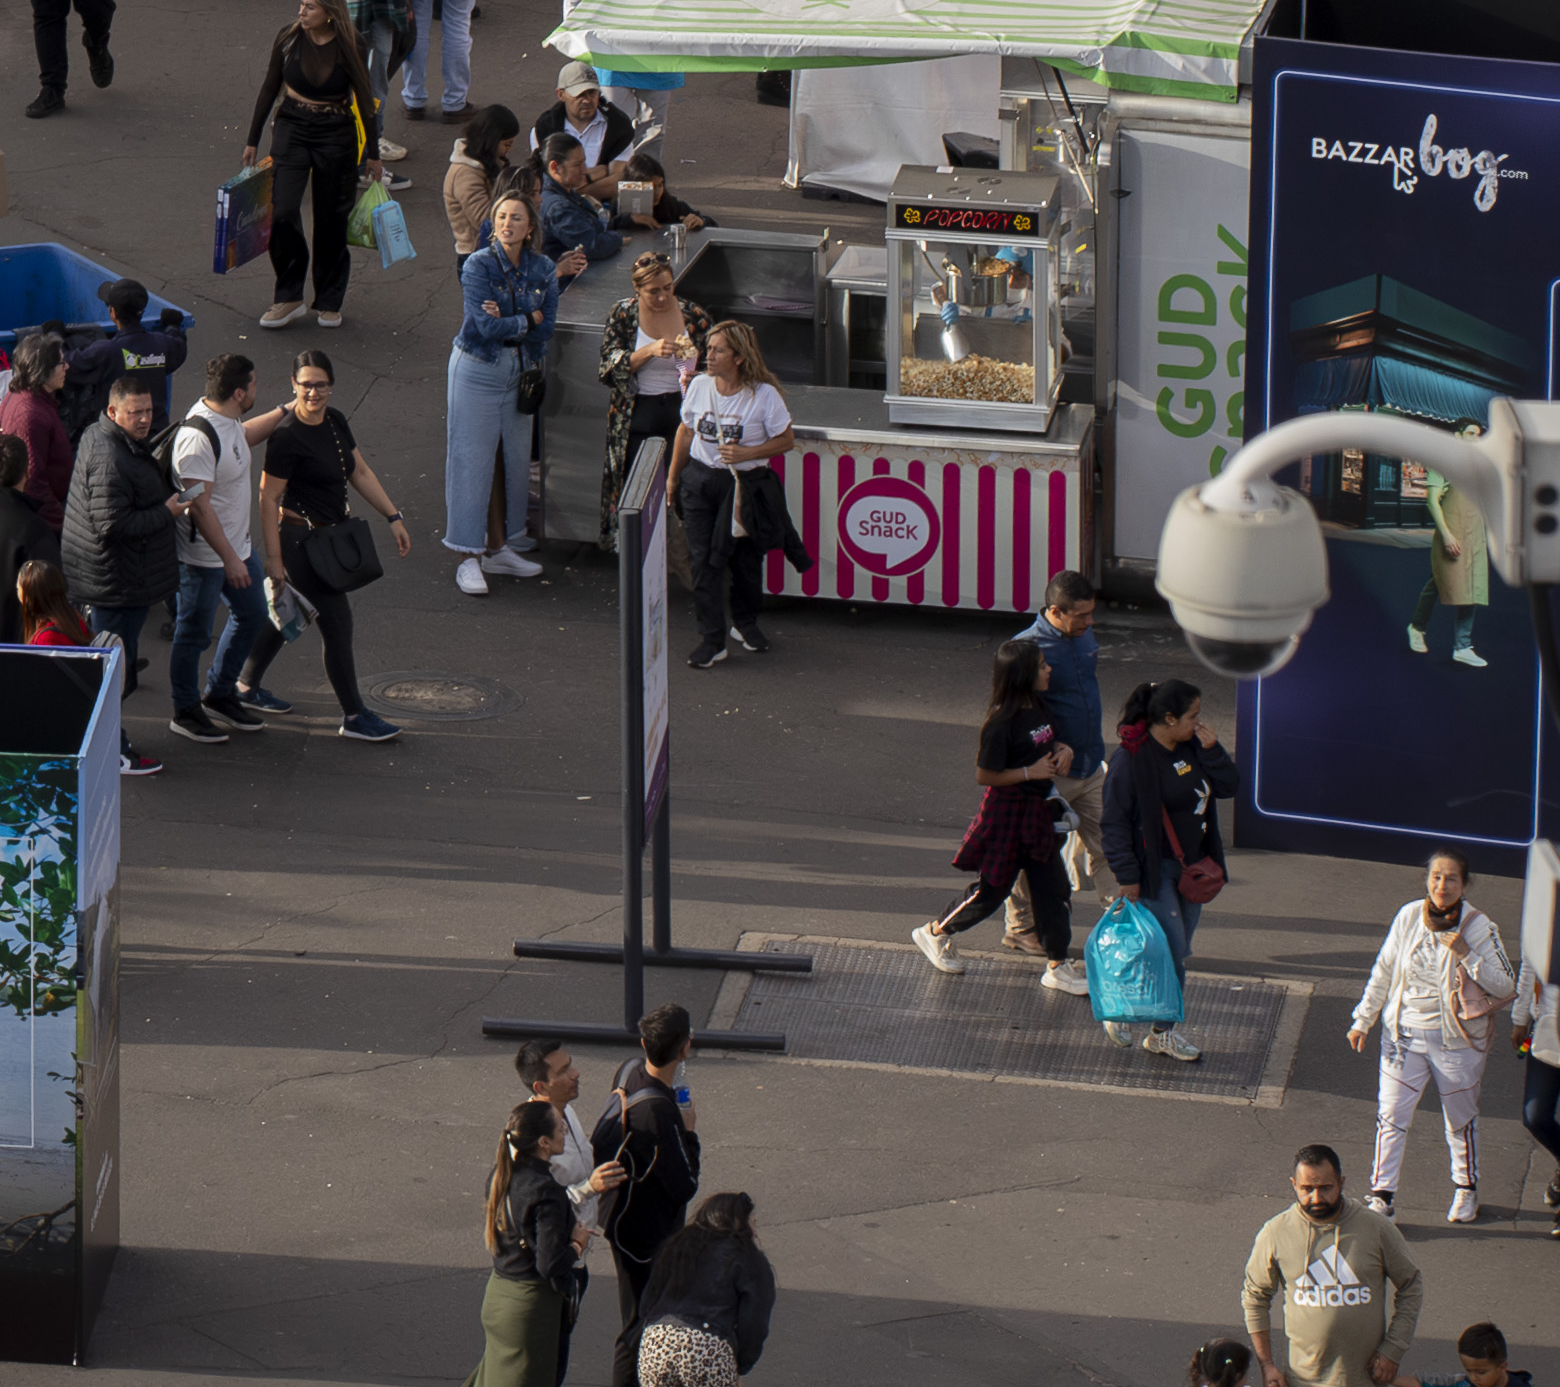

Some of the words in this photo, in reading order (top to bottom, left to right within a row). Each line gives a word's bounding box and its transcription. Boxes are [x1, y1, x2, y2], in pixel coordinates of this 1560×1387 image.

[1311, 137, 1415, 168] BAZZAR
[923, 207, 1014, 230] POPCORN
[1156, 273, 1217, 439] GUD
[869, 509, 907, 525] GUD
[1293, 1284, 1371, 1307] adidas
